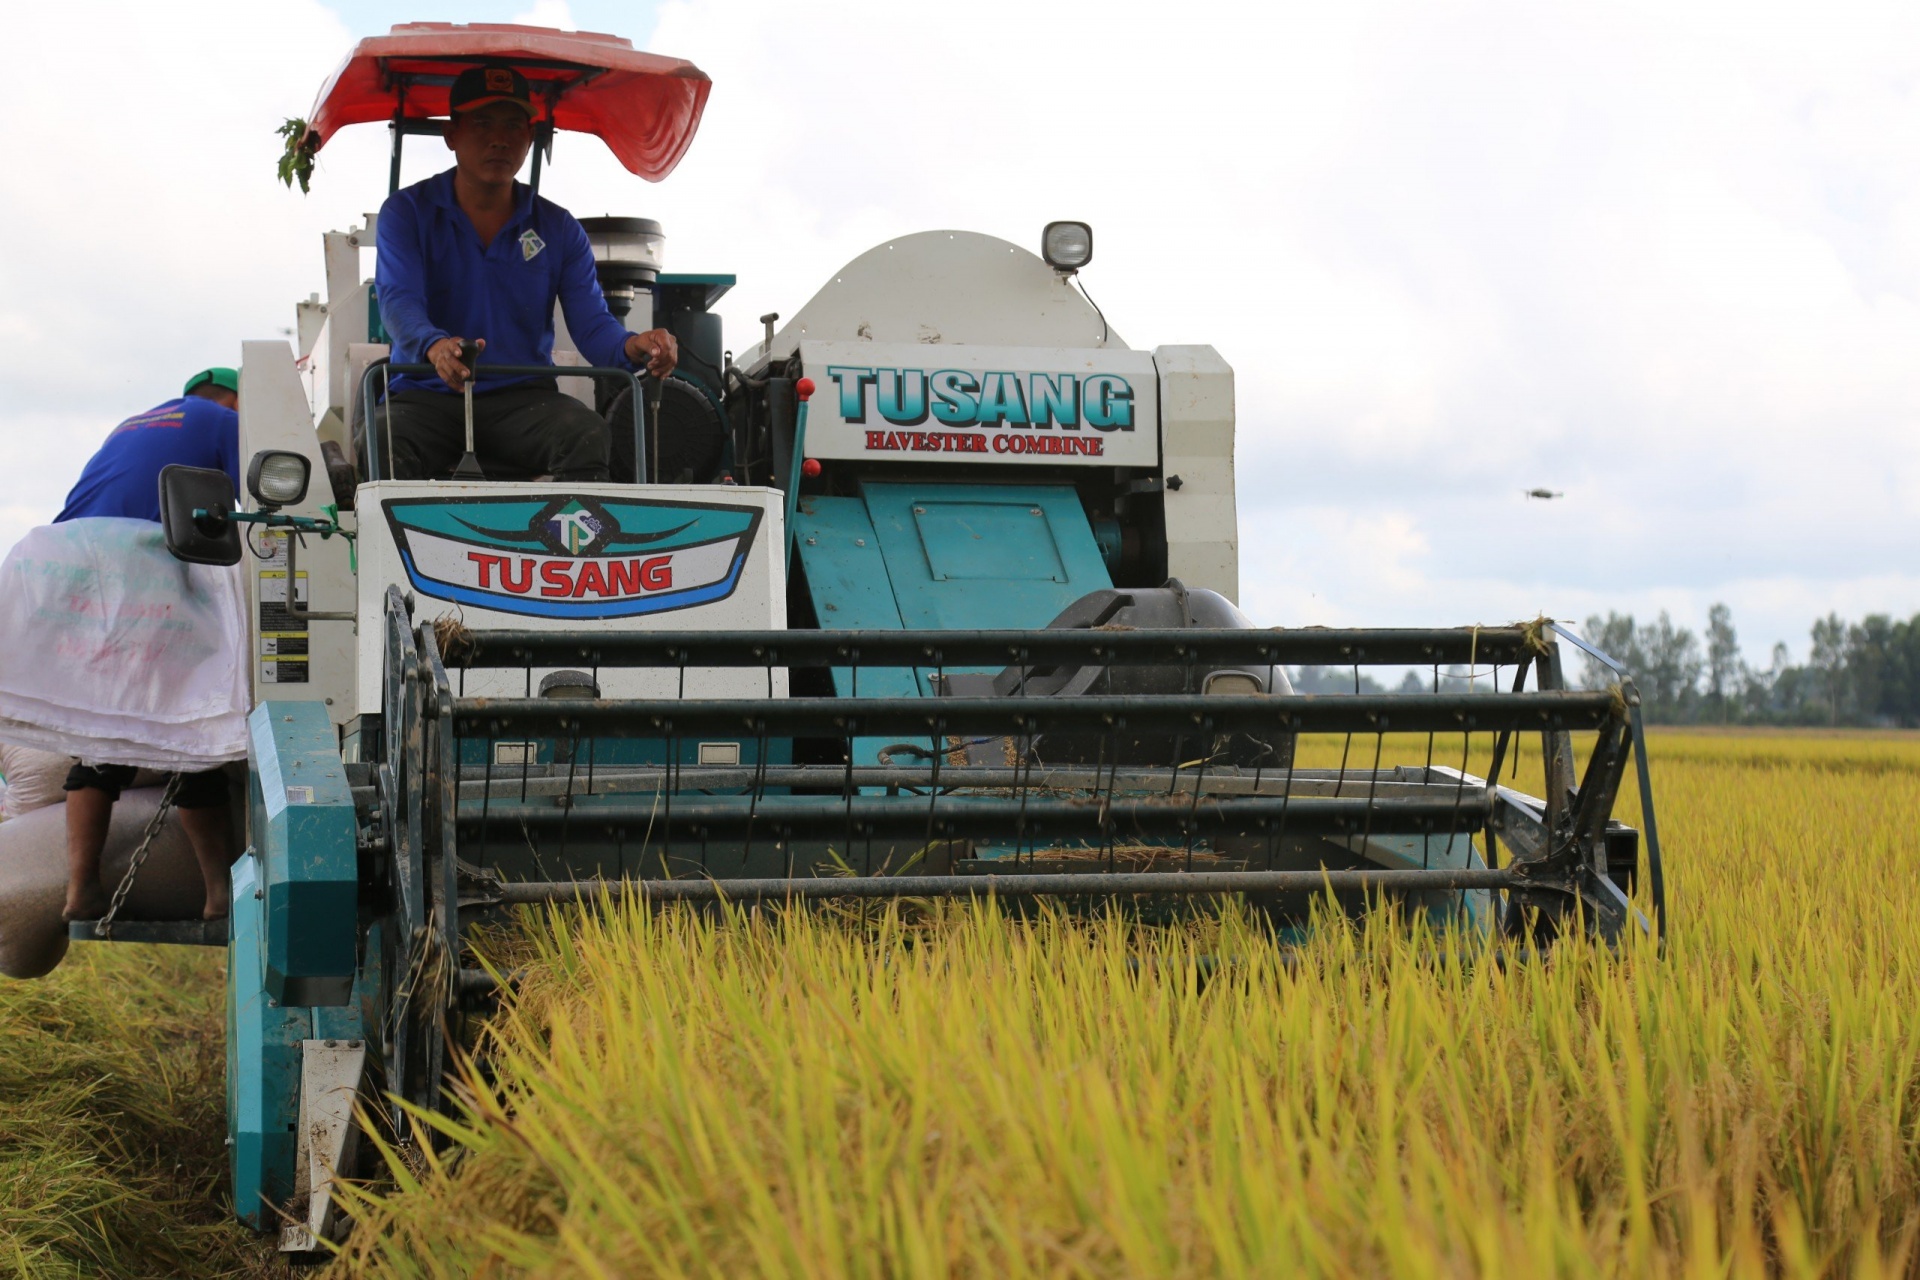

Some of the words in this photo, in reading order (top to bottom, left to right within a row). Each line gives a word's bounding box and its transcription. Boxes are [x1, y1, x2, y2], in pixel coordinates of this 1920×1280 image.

[827, 365, 1135, 432] TUSANG
[865, 430, 989, 452] HAVESTER
[992, 434, 1104, 456] COMBINE
